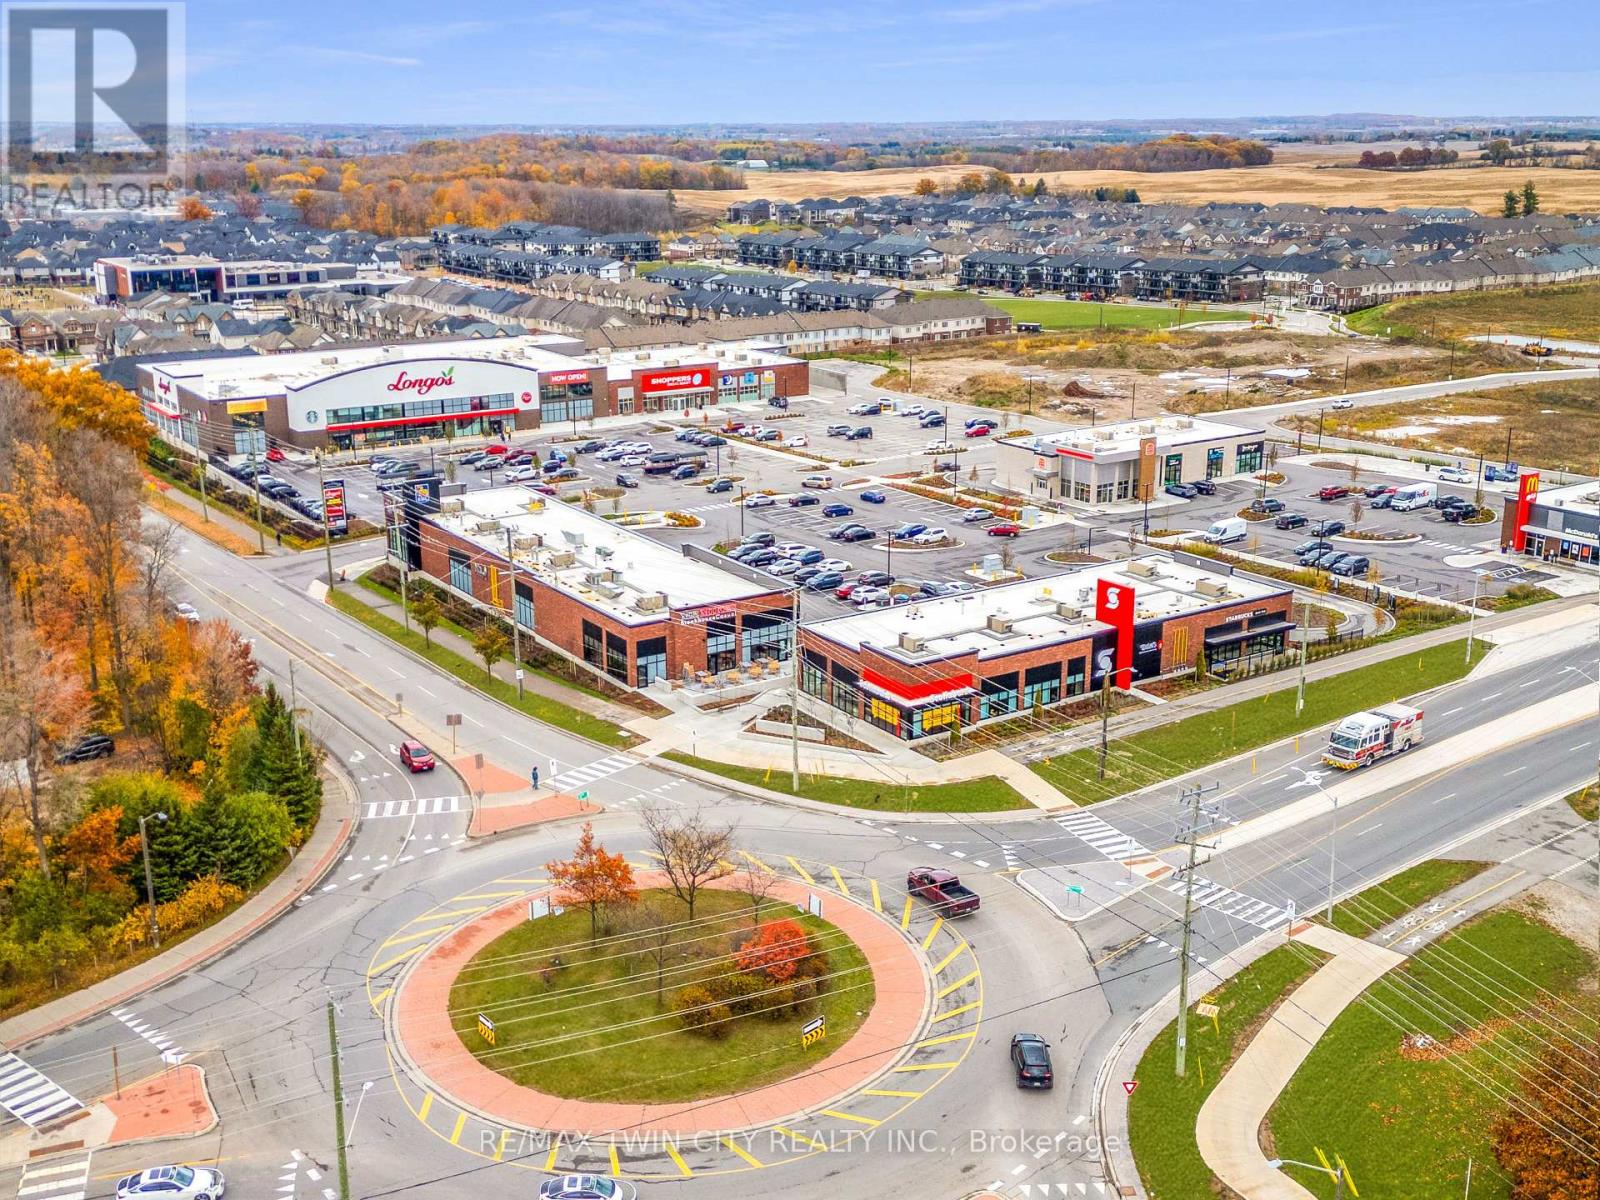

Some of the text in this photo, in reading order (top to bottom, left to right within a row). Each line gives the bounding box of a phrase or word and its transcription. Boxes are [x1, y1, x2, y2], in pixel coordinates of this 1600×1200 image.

[650, 375, 691, 385] SHOPPERS
[1564, 527, 1598, 540] McDonald's
[1225, 611, 1254, 623] STARBUCKS
